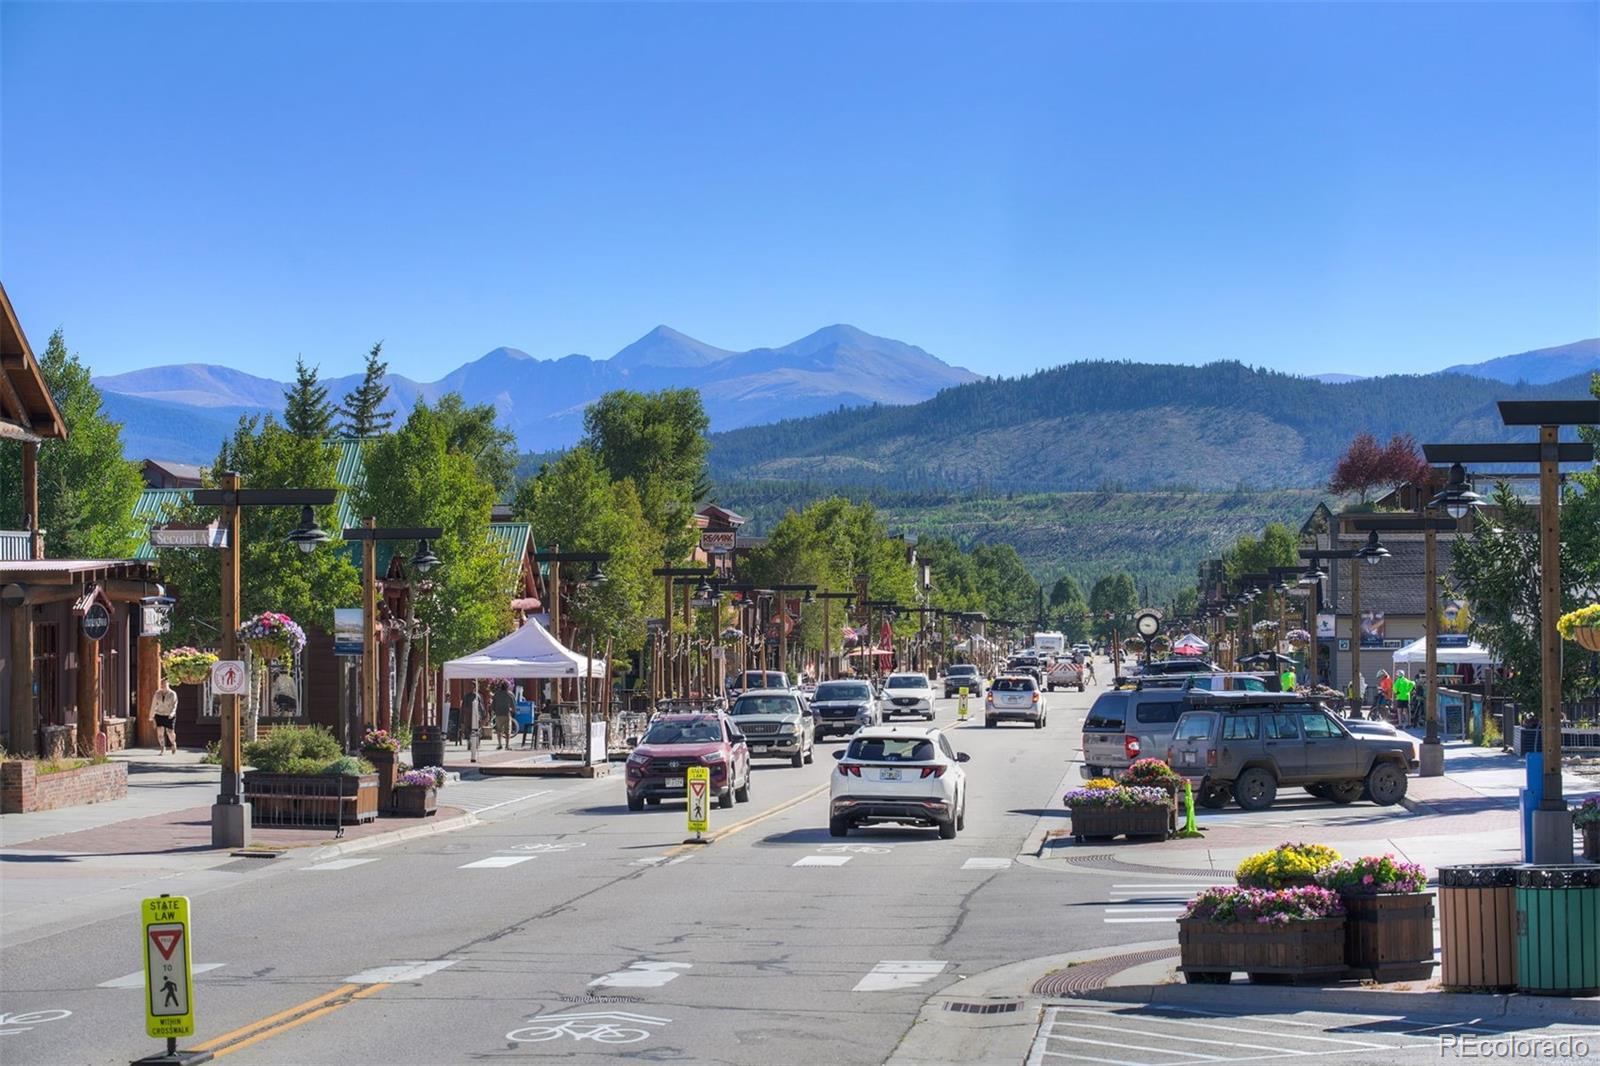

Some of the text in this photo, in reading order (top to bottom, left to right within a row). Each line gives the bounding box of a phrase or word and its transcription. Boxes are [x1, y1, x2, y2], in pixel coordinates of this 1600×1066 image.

[156, 531, 196, 545] Second
[150, 901, 180, 911] STATE
[154, 911, 176, 921] LAW
[163, 964, 173, 972] TO
[160, 1018, 181, 1026] WITHIN
[152, 1026, 189, 1036] CROSSWALK
